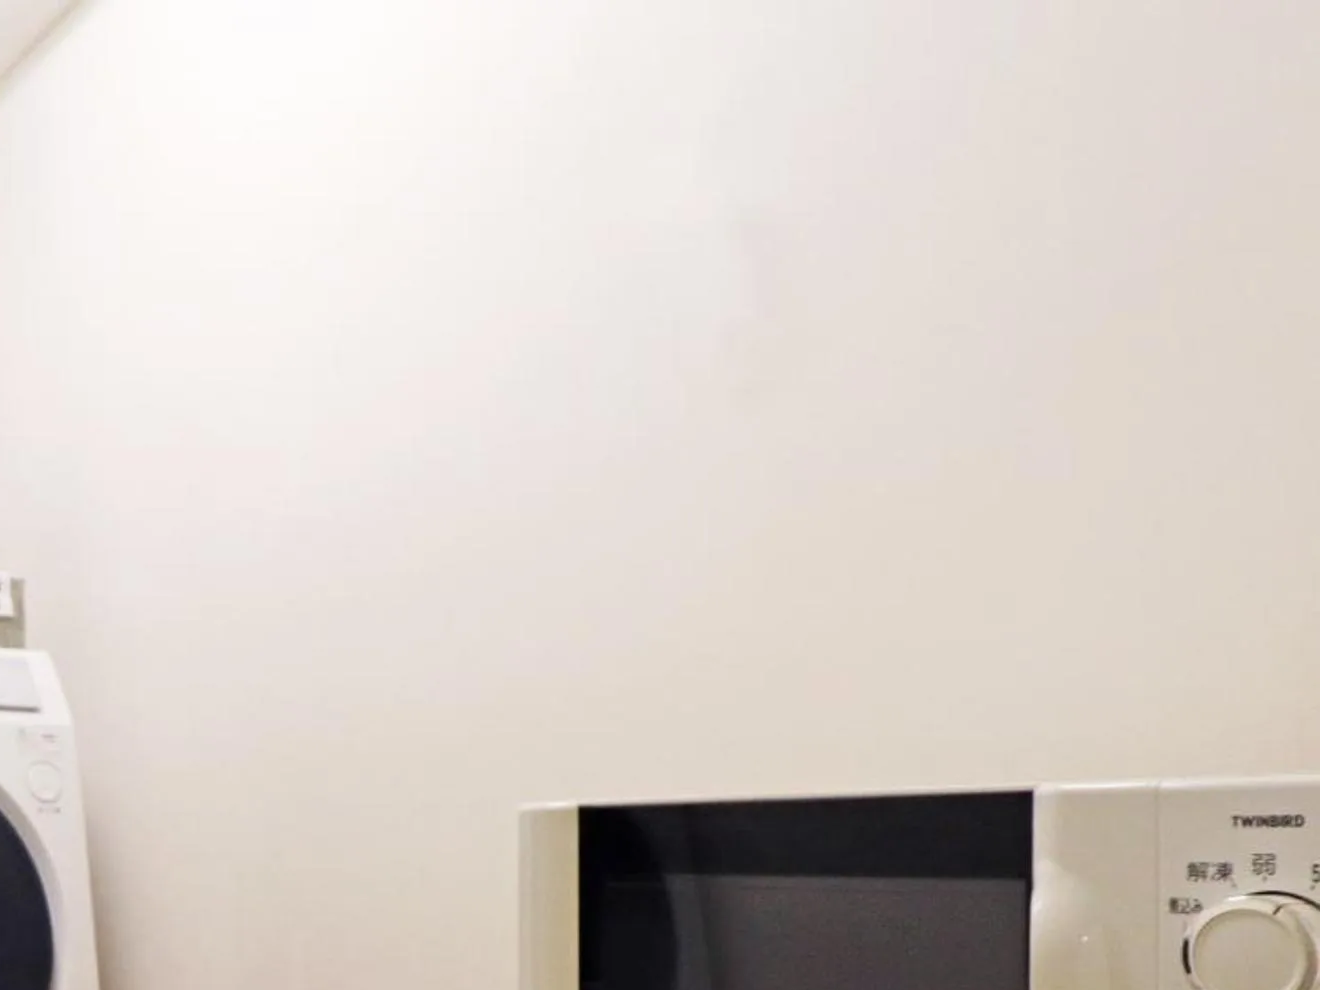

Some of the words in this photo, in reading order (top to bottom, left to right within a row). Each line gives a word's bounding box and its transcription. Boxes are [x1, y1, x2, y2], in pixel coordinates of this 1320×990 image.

[1231, 814, 1305, 828] TWINBIRD
[1187, 862, 1233, 882] 解凍
[1251, 853, 1277, 876] 弱
